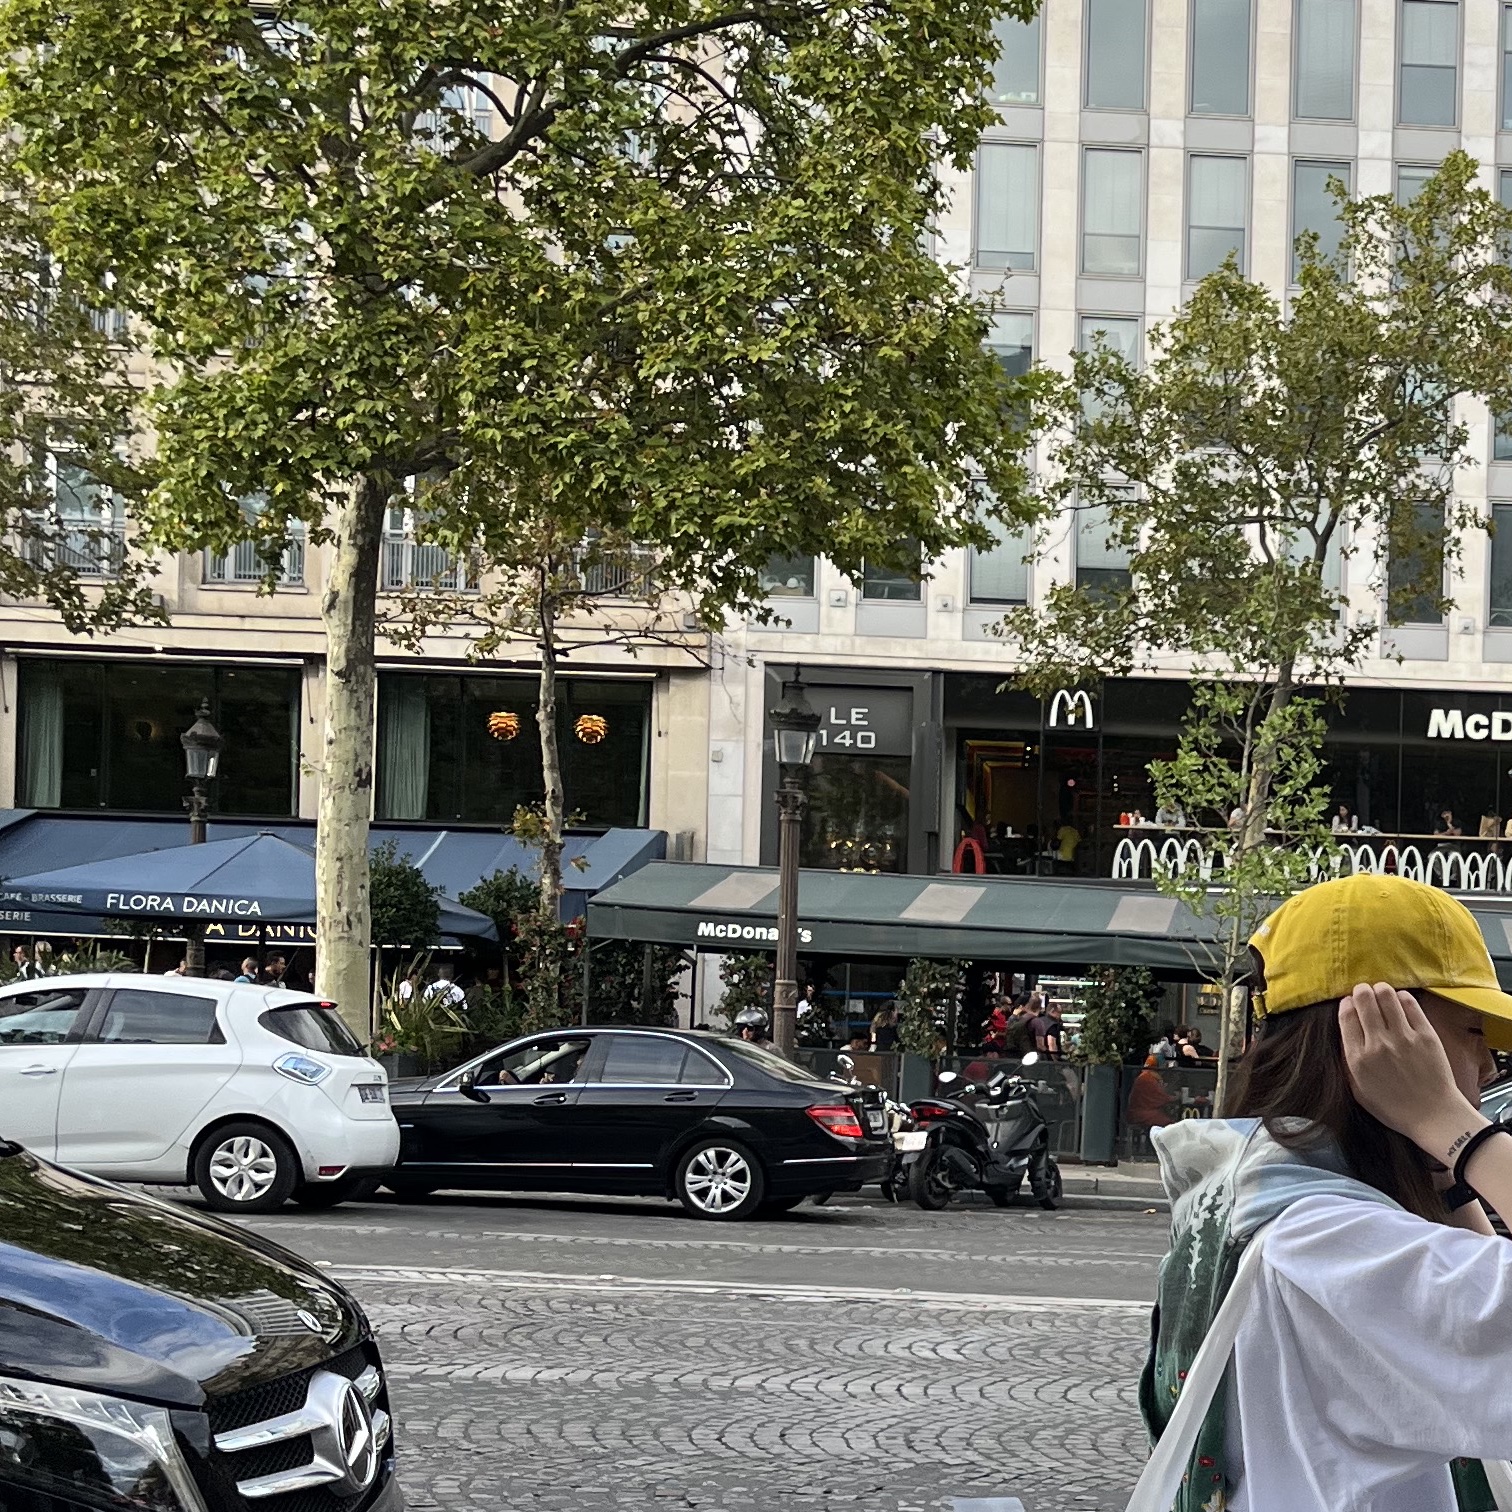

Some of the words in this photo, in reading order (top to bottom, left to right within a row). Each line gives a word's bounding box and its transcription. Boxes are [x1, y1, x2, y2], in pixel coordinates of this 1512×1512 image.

[830, 706, 869, 726] LE
[819, 729, 876, 749] 140
[31, 893, 83, 904] BRASSERIE
[106, 893, 175, 912] FLORA
[182, 896, 262, 916] DANICA
[697, 921, 812, 943] McDona's
